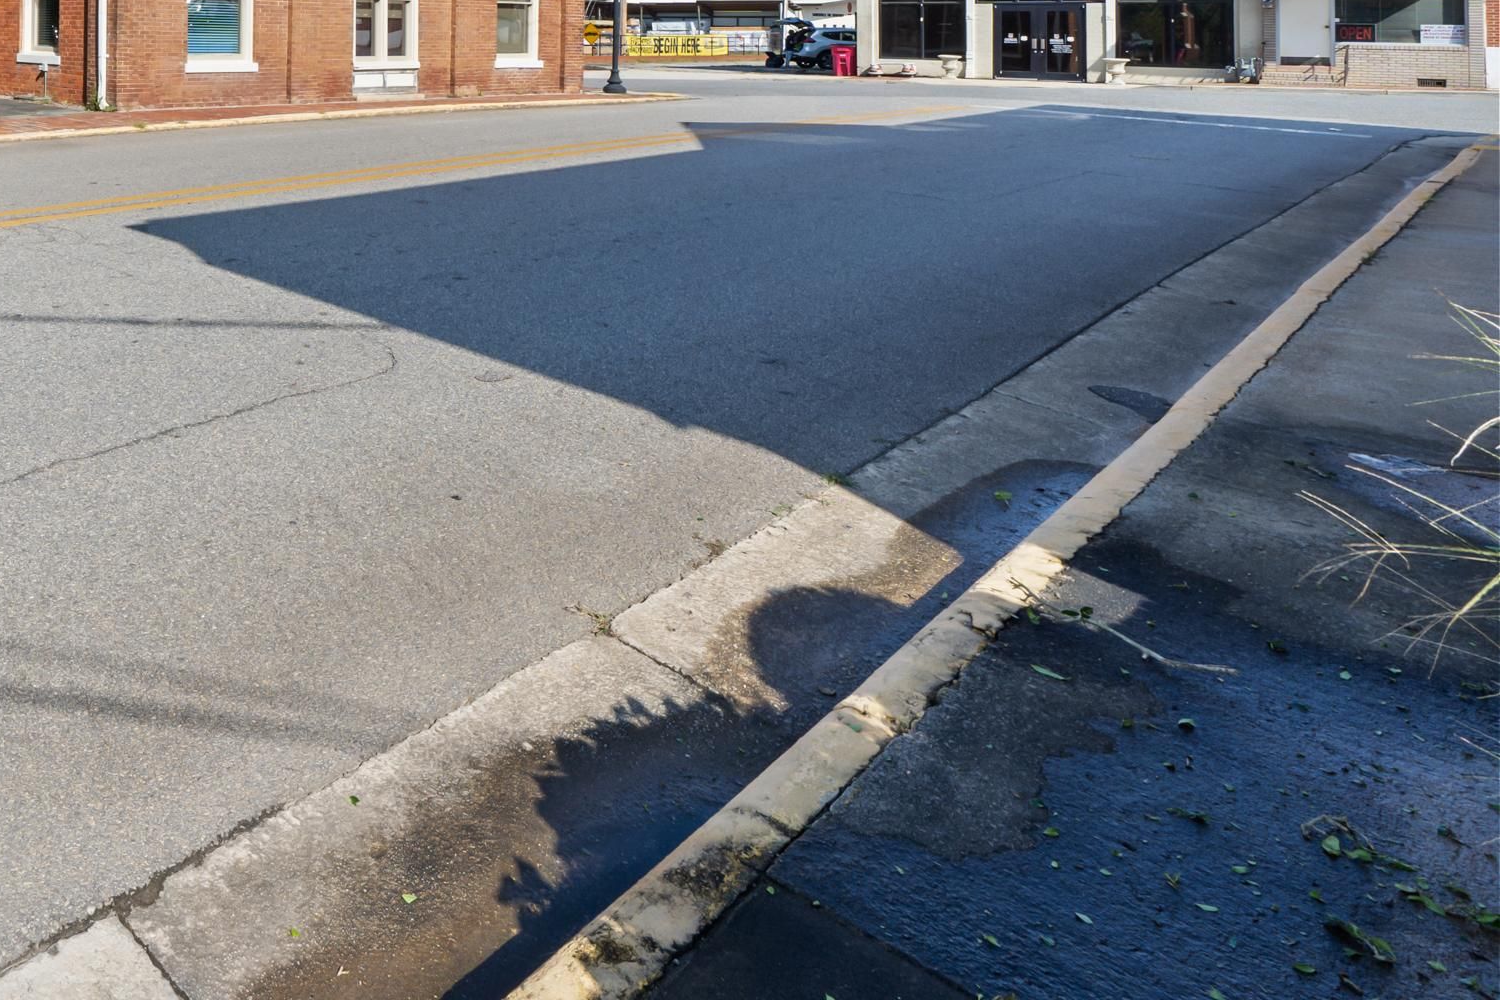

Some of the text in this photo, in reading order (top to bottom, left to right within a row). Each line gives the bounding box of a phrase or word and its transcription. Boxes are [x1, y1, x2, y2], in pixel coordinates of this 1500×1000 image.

[1340, 26, 1372, 40] OPEN
[653, 38, 678, 54] BEGIN
[681, 38, 701, 53] HERE
